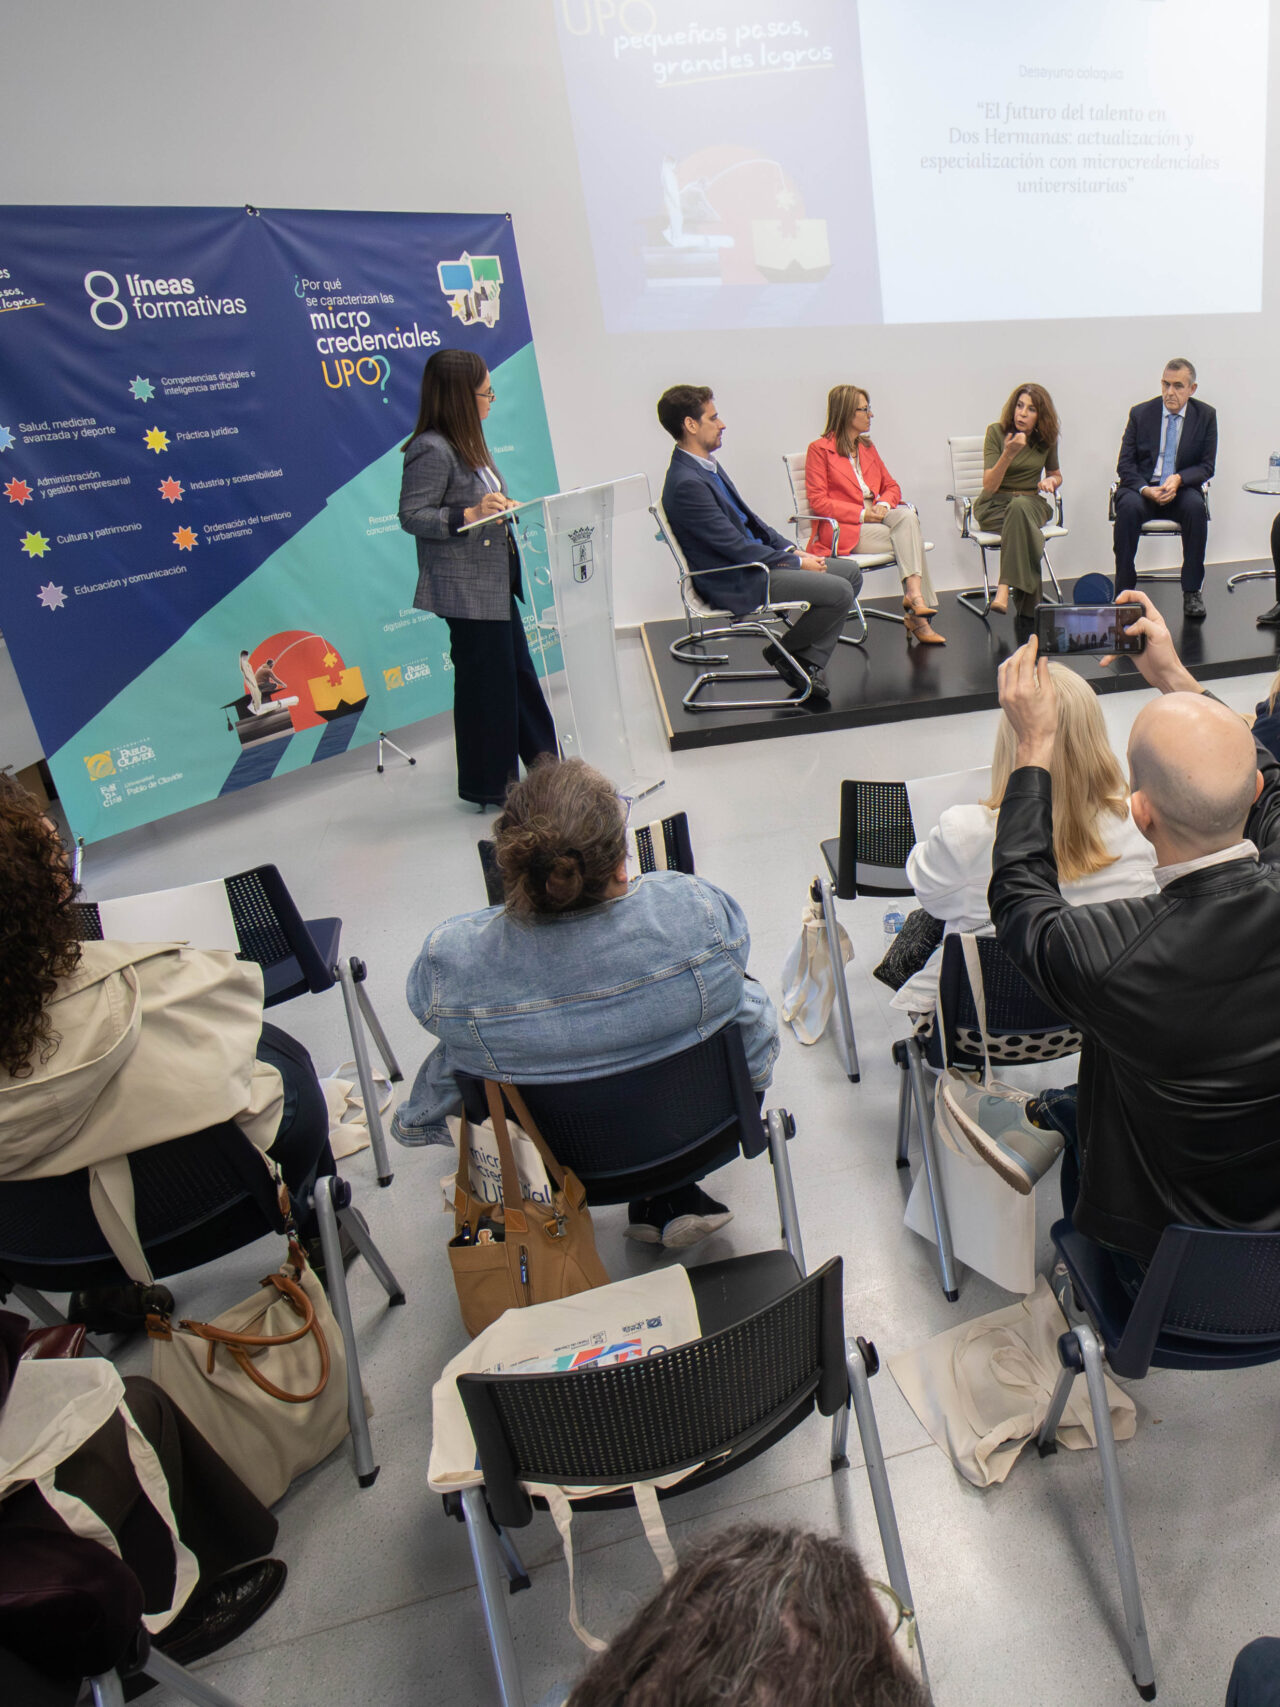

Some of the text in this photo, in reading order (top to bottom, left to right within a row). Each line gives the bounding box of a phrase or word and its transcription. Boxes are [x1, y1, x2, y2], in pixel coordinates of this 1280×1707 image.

[614, 20, 808, 58] pequeños pasos,
[654, 44, 833, 84] grandes logros
[1002, 103, 1056, 124] futuro
[1061, 103, 1084, 120] del
[1089, 104, 1144, 122] talento
[1148, 108, 1166, 122] en
[948, 127, 1194, 150] Dos Hermanas: actualización y
[920, 152, 1220, 174] especialización con microcredenciales
[126, 273, 195, 296] líneas
[324, 278, 342, 292] qué
[2, 298, 37, 310] logros
[84, 270, 128, 330] 8
[133, 295, 247, 319] formativas
[306, 292, 394, 306] se caracterizan las
[310, 306, 370, 330] micro
[316, 322, 440, 354] credenciales
[161, 372, 217, 386] Competencias
[218, 370, 250, 382] digitales
[164, 380, 240, 395] inteligencia artificial
[18, 417, 96, 432] Salud, medicina
[23, 426, 116, 444] avanzada y deporte
[176, 426, 238, 440] Práctica jurídica
[37, 470, 101, 486] Administración
[40, 476, 131, 499] y gestión empresarial
[190, 478, 224, 490] Industria
[232, 468, 284, 484] sostenibilidad
[56, 522, 142, 544] Cultura y patrimonio
[204, 511, 292, 533] Ordenación del territorio
[213, 528, 252, 542] urbanismo
[74, 566, 187, 595] Educación y comunicación
[470, 1147, 499, 1168] micr
